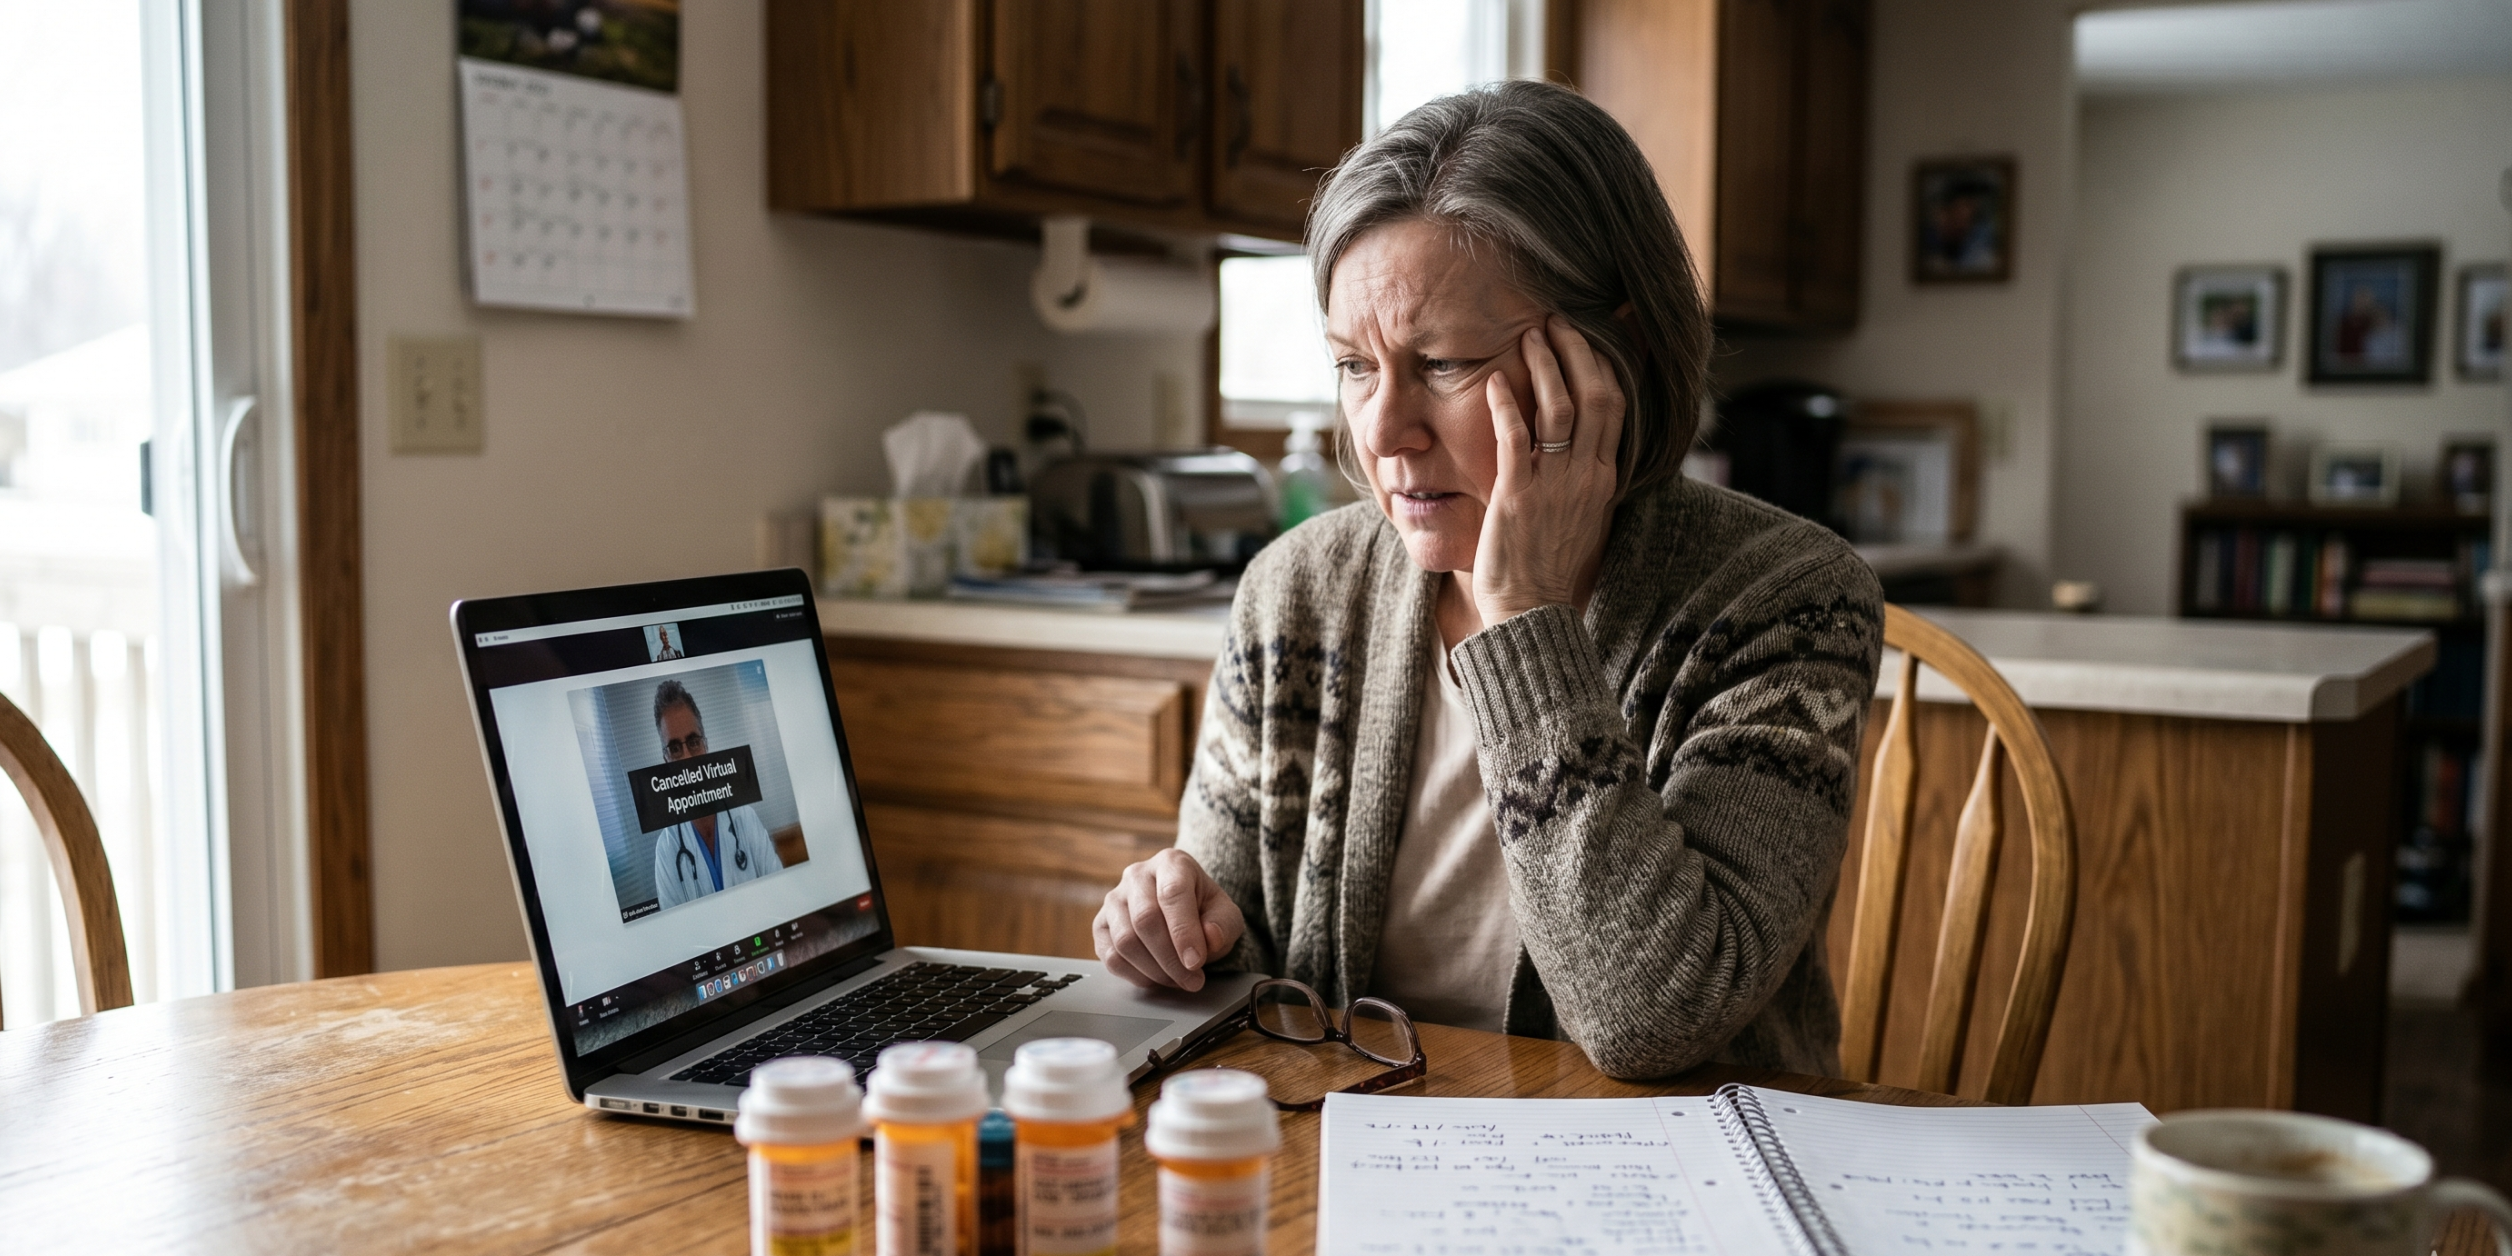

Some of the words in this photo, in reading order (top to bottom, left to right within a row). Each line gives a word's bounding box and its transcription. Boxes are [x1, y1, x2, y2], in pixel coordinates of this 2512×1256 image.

[651, 766, 703, 792] Cancelled
[702, 758, 737, 780] Virtual
[667, 782, 733, 814] Appointment
